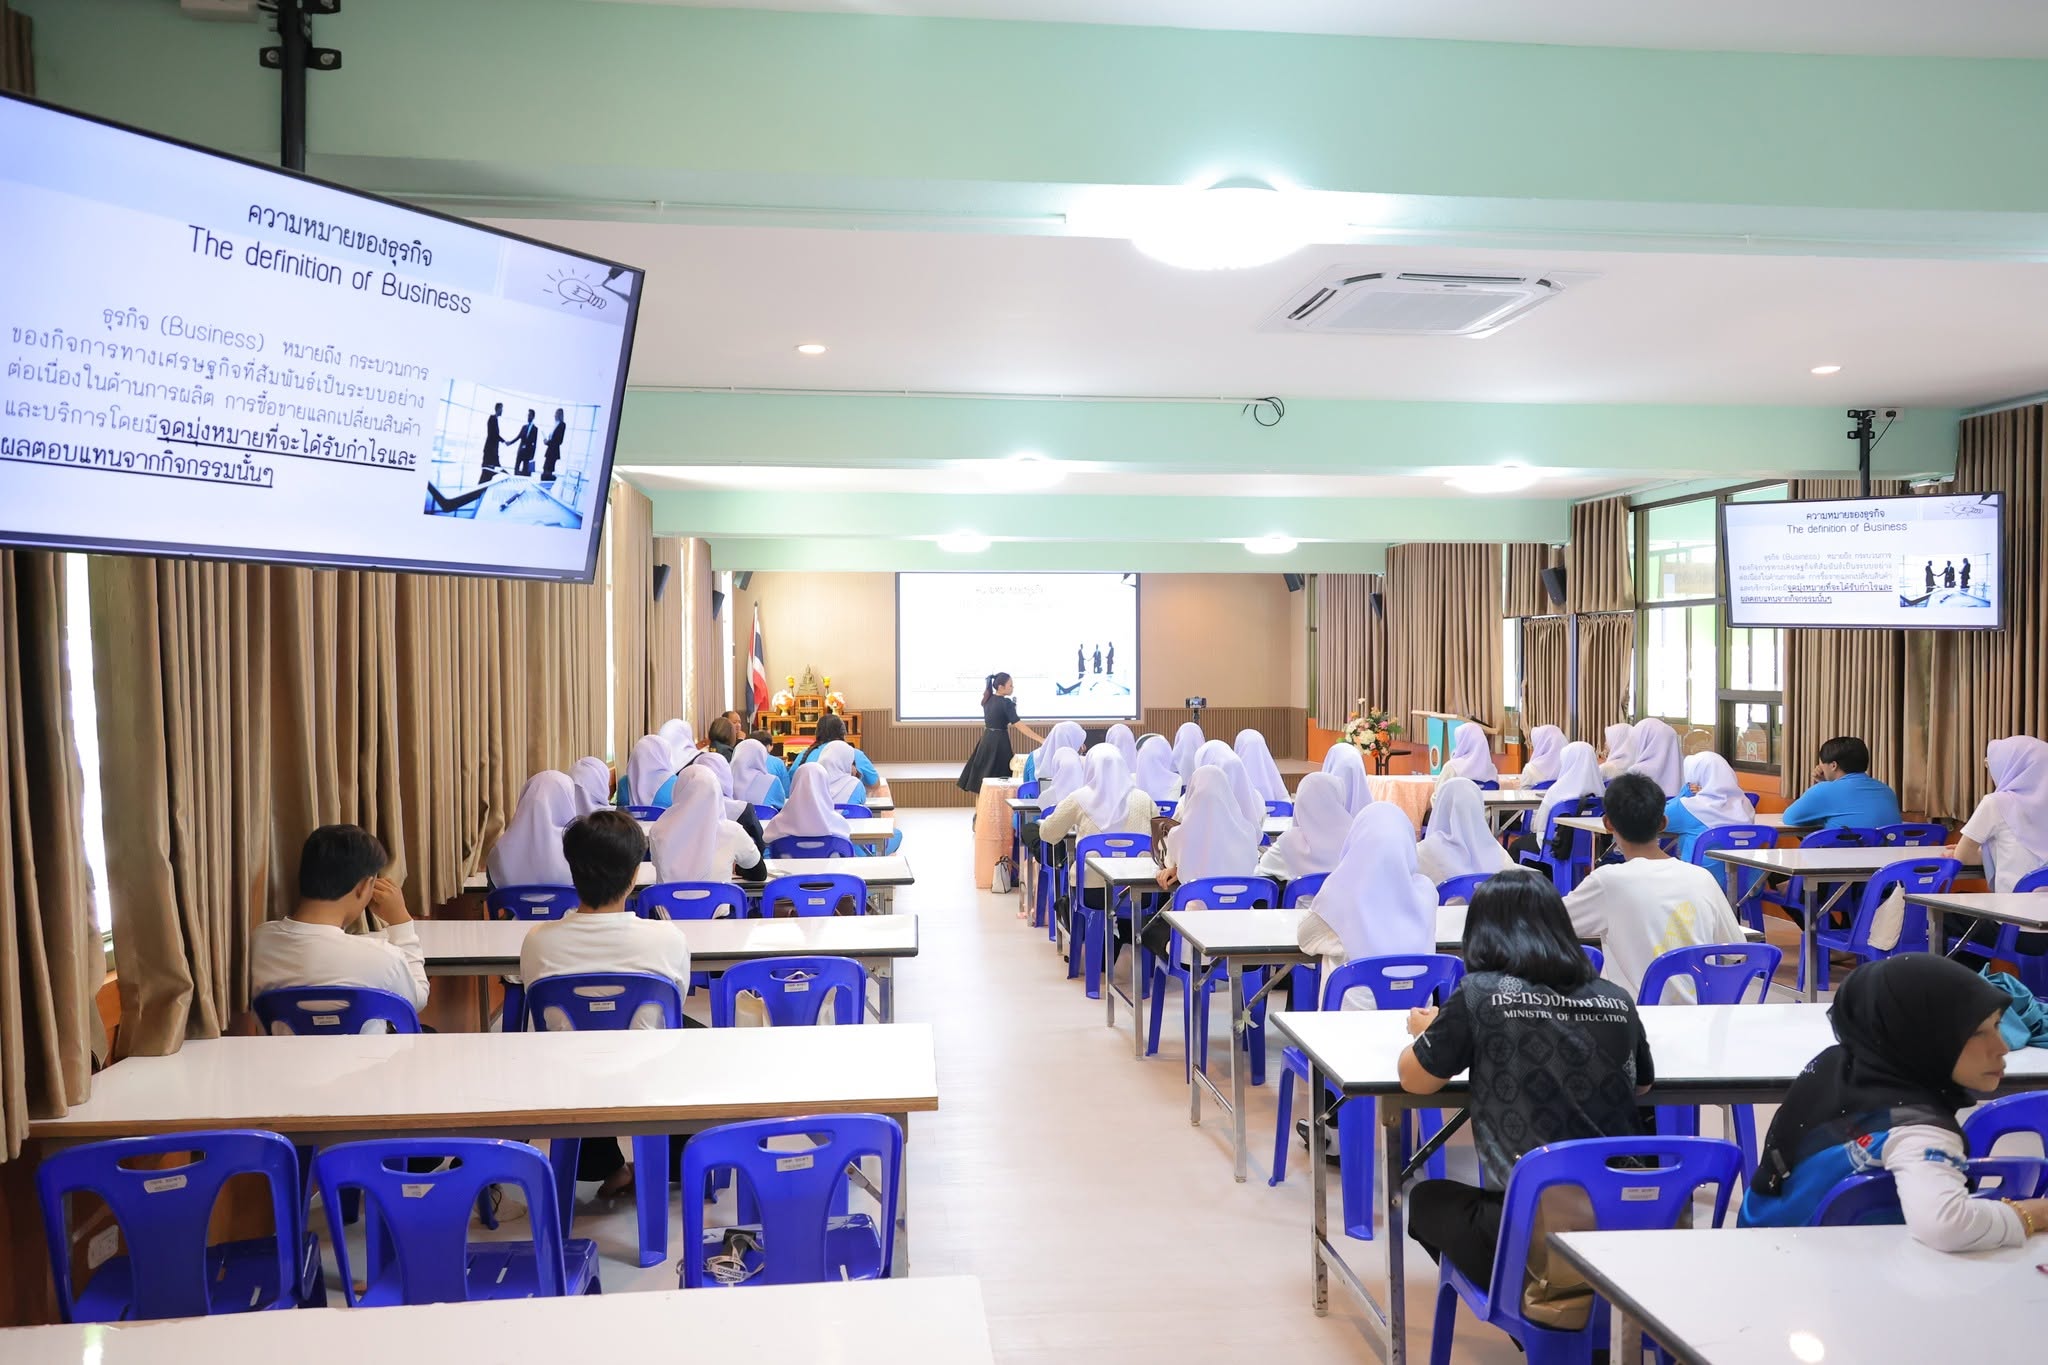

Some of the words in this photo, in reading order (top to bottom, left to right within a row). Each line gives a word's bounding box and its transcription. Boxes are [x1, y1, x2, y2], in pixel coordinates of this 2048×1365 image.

[248, 204, 433, 266] ความหมายของธุรกิจ
[188, 224, 233, 260] The
[245, 240, 342, 285] definition
[352, 270, 373, 291] of
[382, 272, 472, 314] Business
[103, 307, 150, 331] ธุรกิจ
[160, 315, 264, 352] (Business)
[283, 340, 342, 365] หมายถึง
[350, 353, 429, 381] กระบวนการ
[1787, 524, 1804, 534] The
[1808, 523, 1846, 534] definition
[1850, 523, 1859, 533] of
[1863, 522, 1907, 532] Business
[1492, 992, 1629, 1012] กระทรวงศกษาธิการ
[1504, 1009, 1553, 1020] MINISTRY
[1557, 1012, 1570, 1022] OF
[1575, 1013, 1628, 1024] EDUCATION
